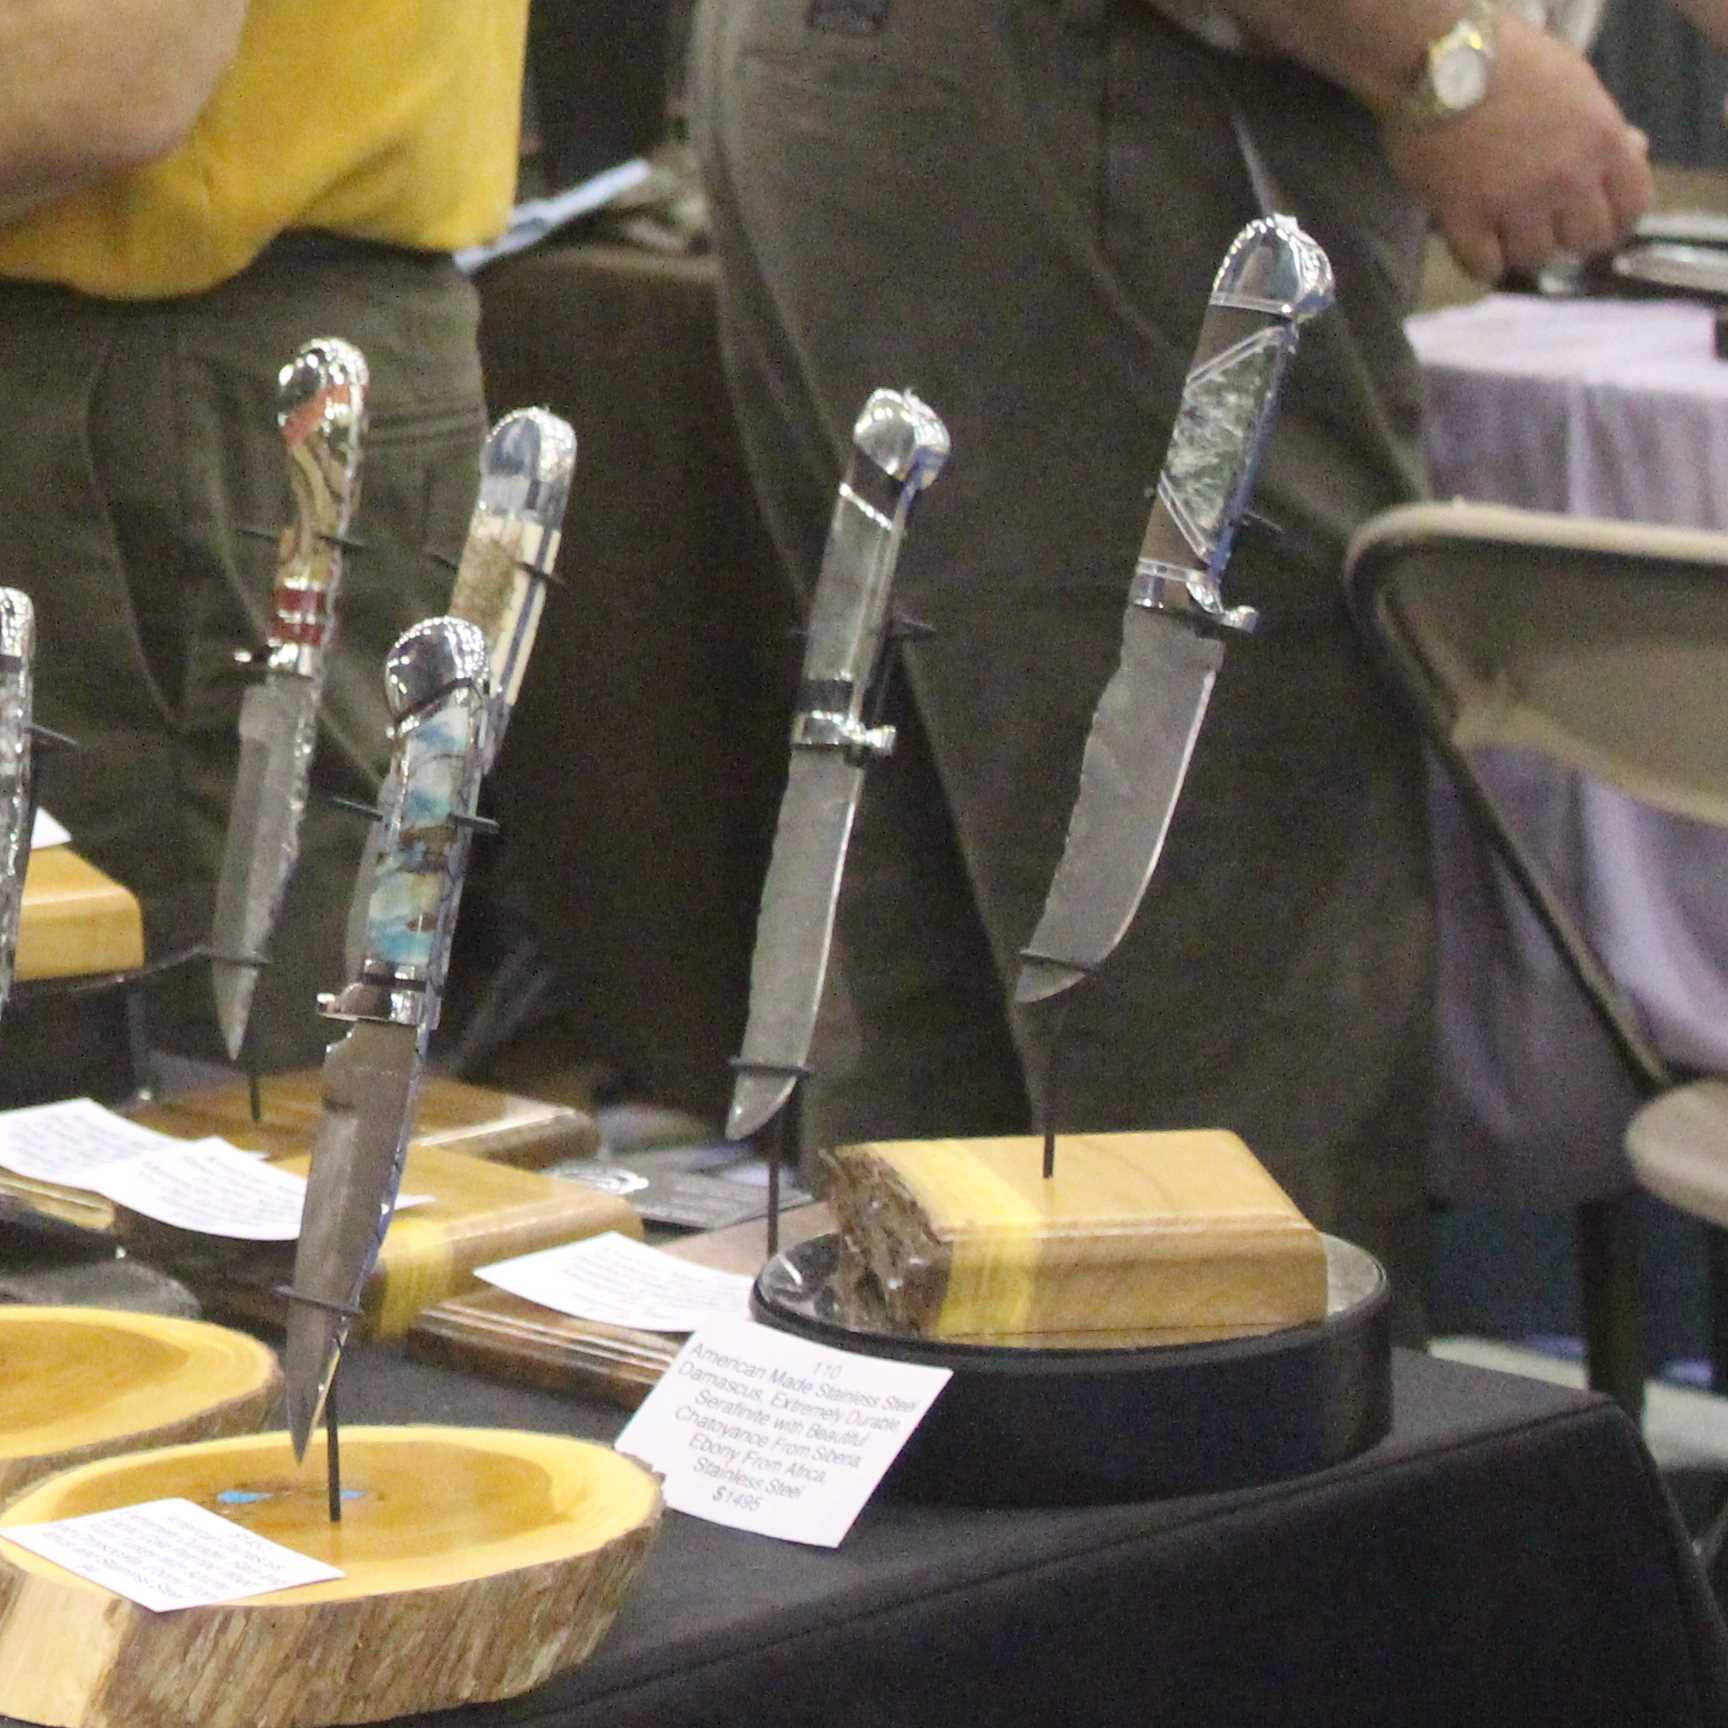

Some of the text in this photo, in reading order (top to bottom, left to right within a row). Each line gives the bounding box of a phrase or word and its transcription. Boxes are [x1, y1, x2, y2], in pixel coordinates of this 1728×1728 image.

[690, 1342, 920, 1414] American Made Stainless Steel
[694, 1388, 871, 1448] Serafinite with Beautiful
[770, 1391, 843, 1423] Extremely
[674, 1404, 770, 1449] Chatoyance
[772, 1436, 811, 1459] From
[688, 1433, 739, 1463] Ebony
[742, 1449, 784, 1474] From
[692, 1456, 804, 1500] Stainless Steel
[712, 1485, 763, 1512] $1495
